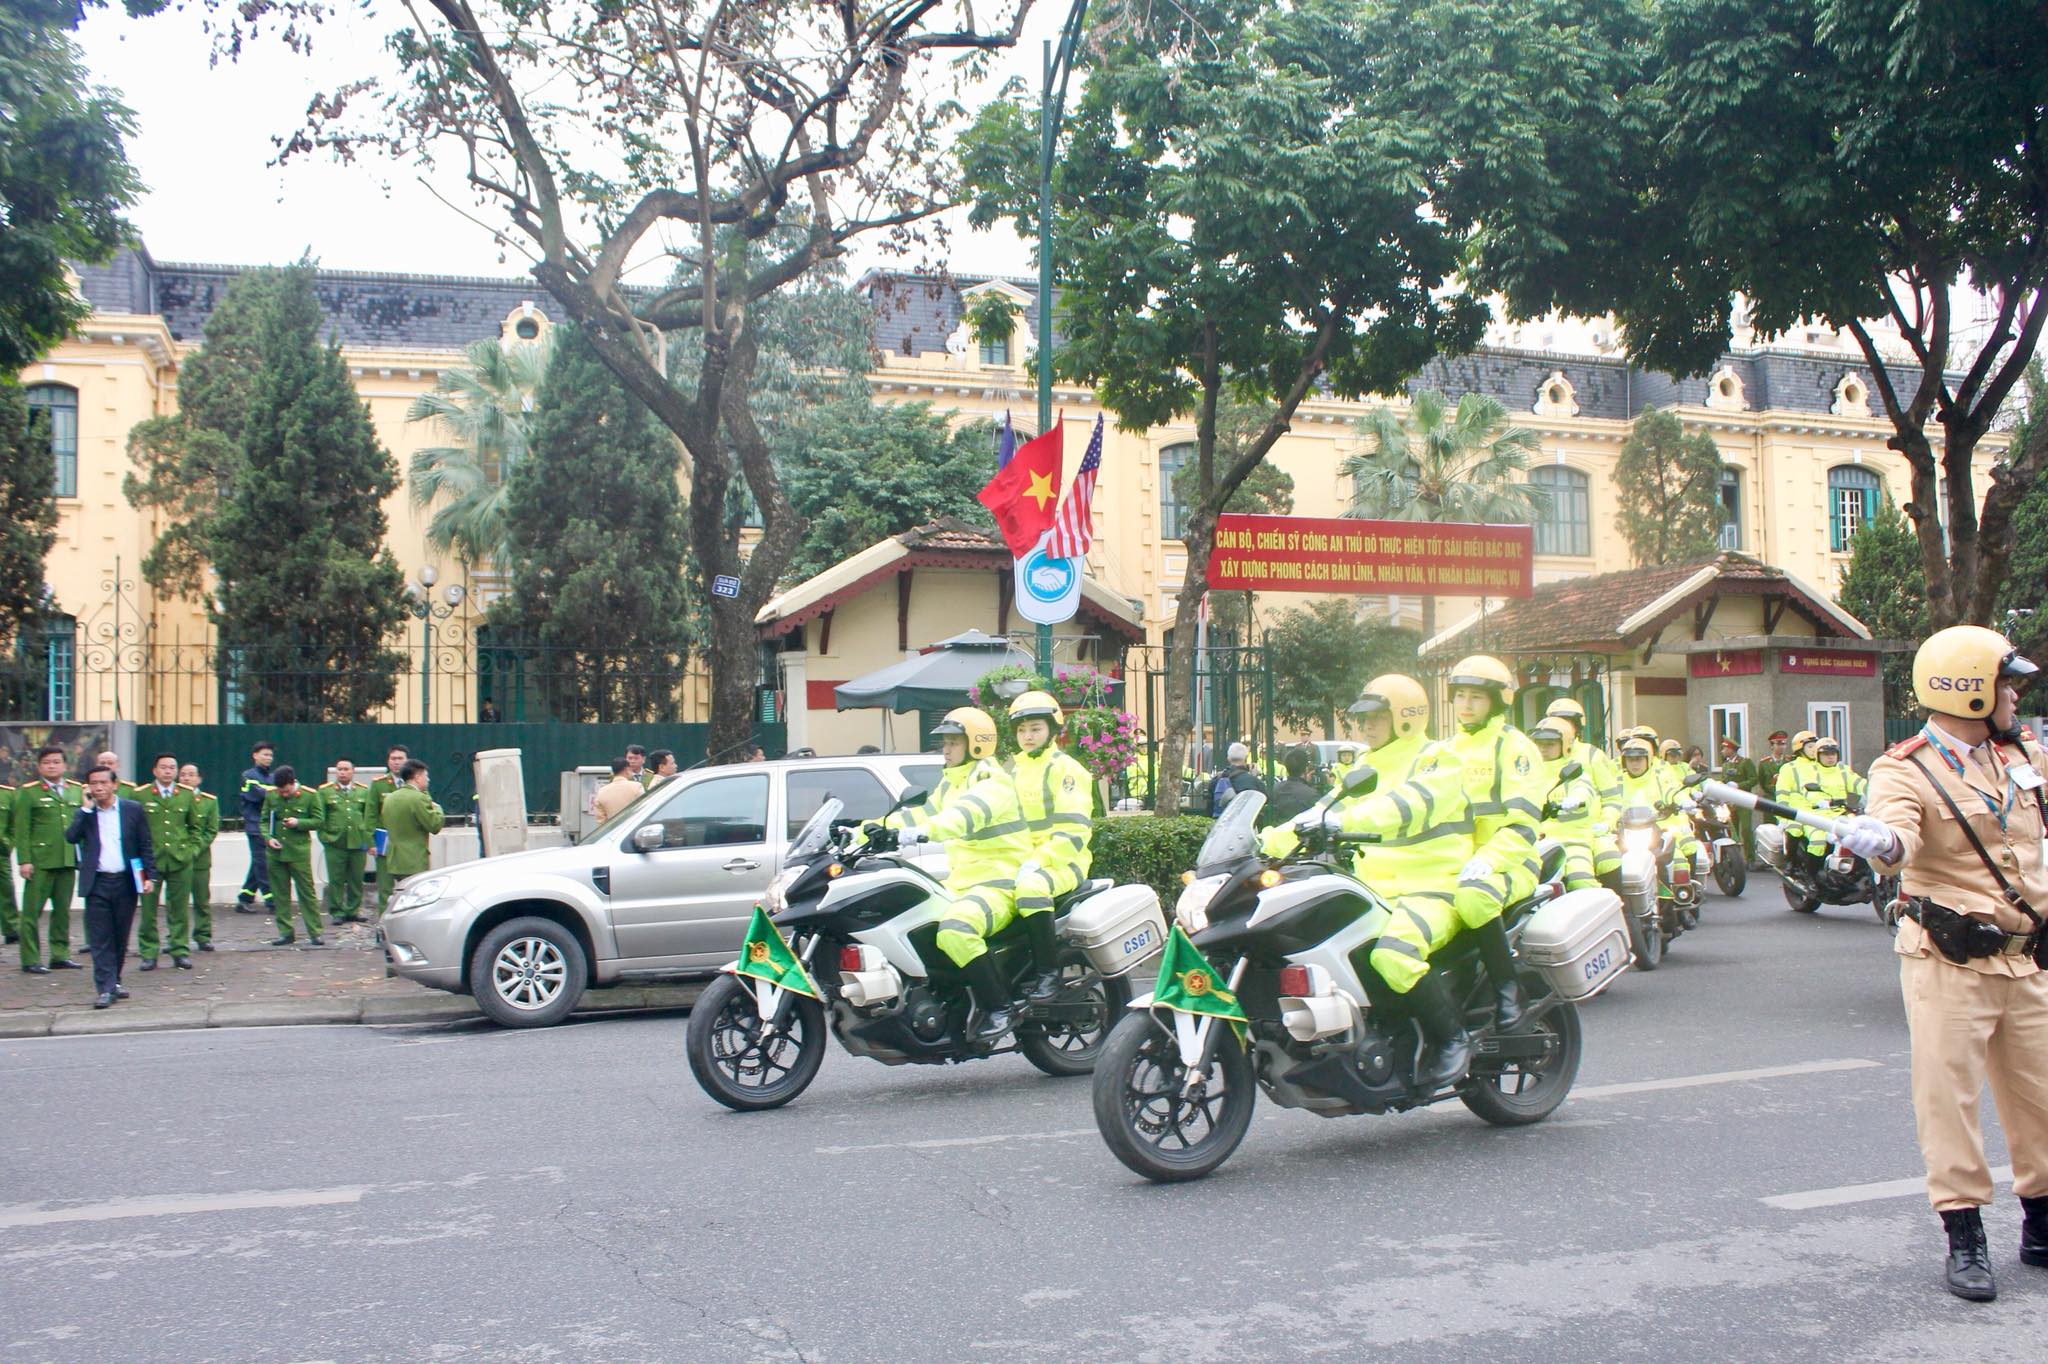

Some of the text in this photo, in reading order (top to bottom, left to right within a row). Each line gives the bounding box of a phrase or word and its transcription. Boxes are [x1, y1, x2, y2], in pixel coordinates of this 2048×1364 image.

[1257, 528, 1285, 550] CHIẾN
[1287, 530, 1300, 551] SỸ
[1302, 531, 1328, 551] CÔNG
[1329, 535, 1343, 553] AN
[1345, 531, 1362, 553] THỦ
[1379, 535, 1402, 558] THỰC
[1403, 535, 1425, 559] HIỆN
[1220, 557, 1239, 577] XÂY
[1241, 559, 1268, 582] DỰNG
[1270, 561, 1302, 580] PHONG
[1304, 559, 1329, 580] CÁCH
[1331, 558, 1351, 581] BẢN
[1378, 562, 1403, 583] NHÂN
[716, 585, 733, 595] 323
[1929, 676, 1984, 692] CSGT
[1124, 930, 1150, 954] CSGT
[1585, 948, 1610, 979] CSGT
